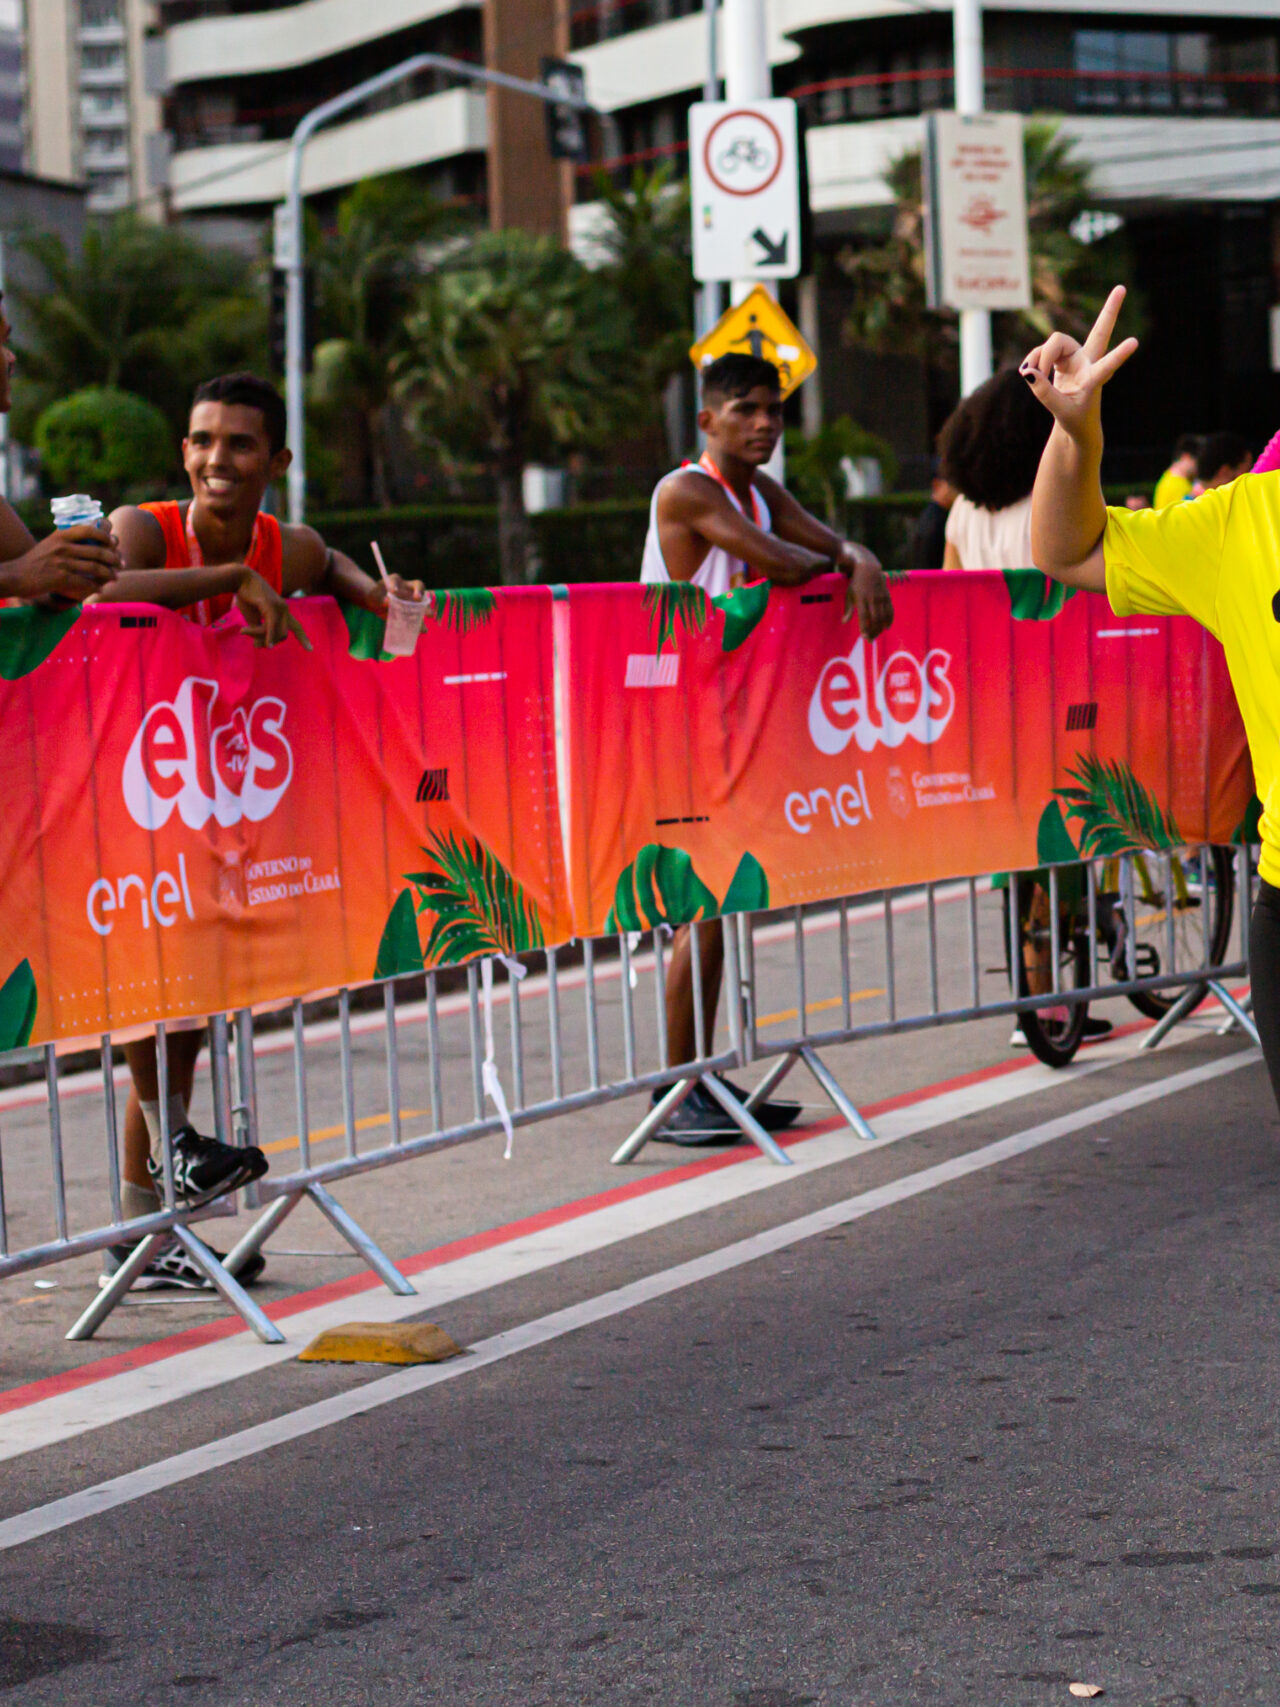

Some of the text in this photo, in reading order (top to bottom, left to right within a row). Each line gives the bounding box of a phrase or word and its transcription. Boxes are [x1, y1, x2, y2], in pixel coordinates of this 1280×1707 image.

[808, 635, 955, 756] elos
[122, 675, 293, 831] elos
[784, 768, 873, 834] enel
[86, 852, 196, 936] enel
